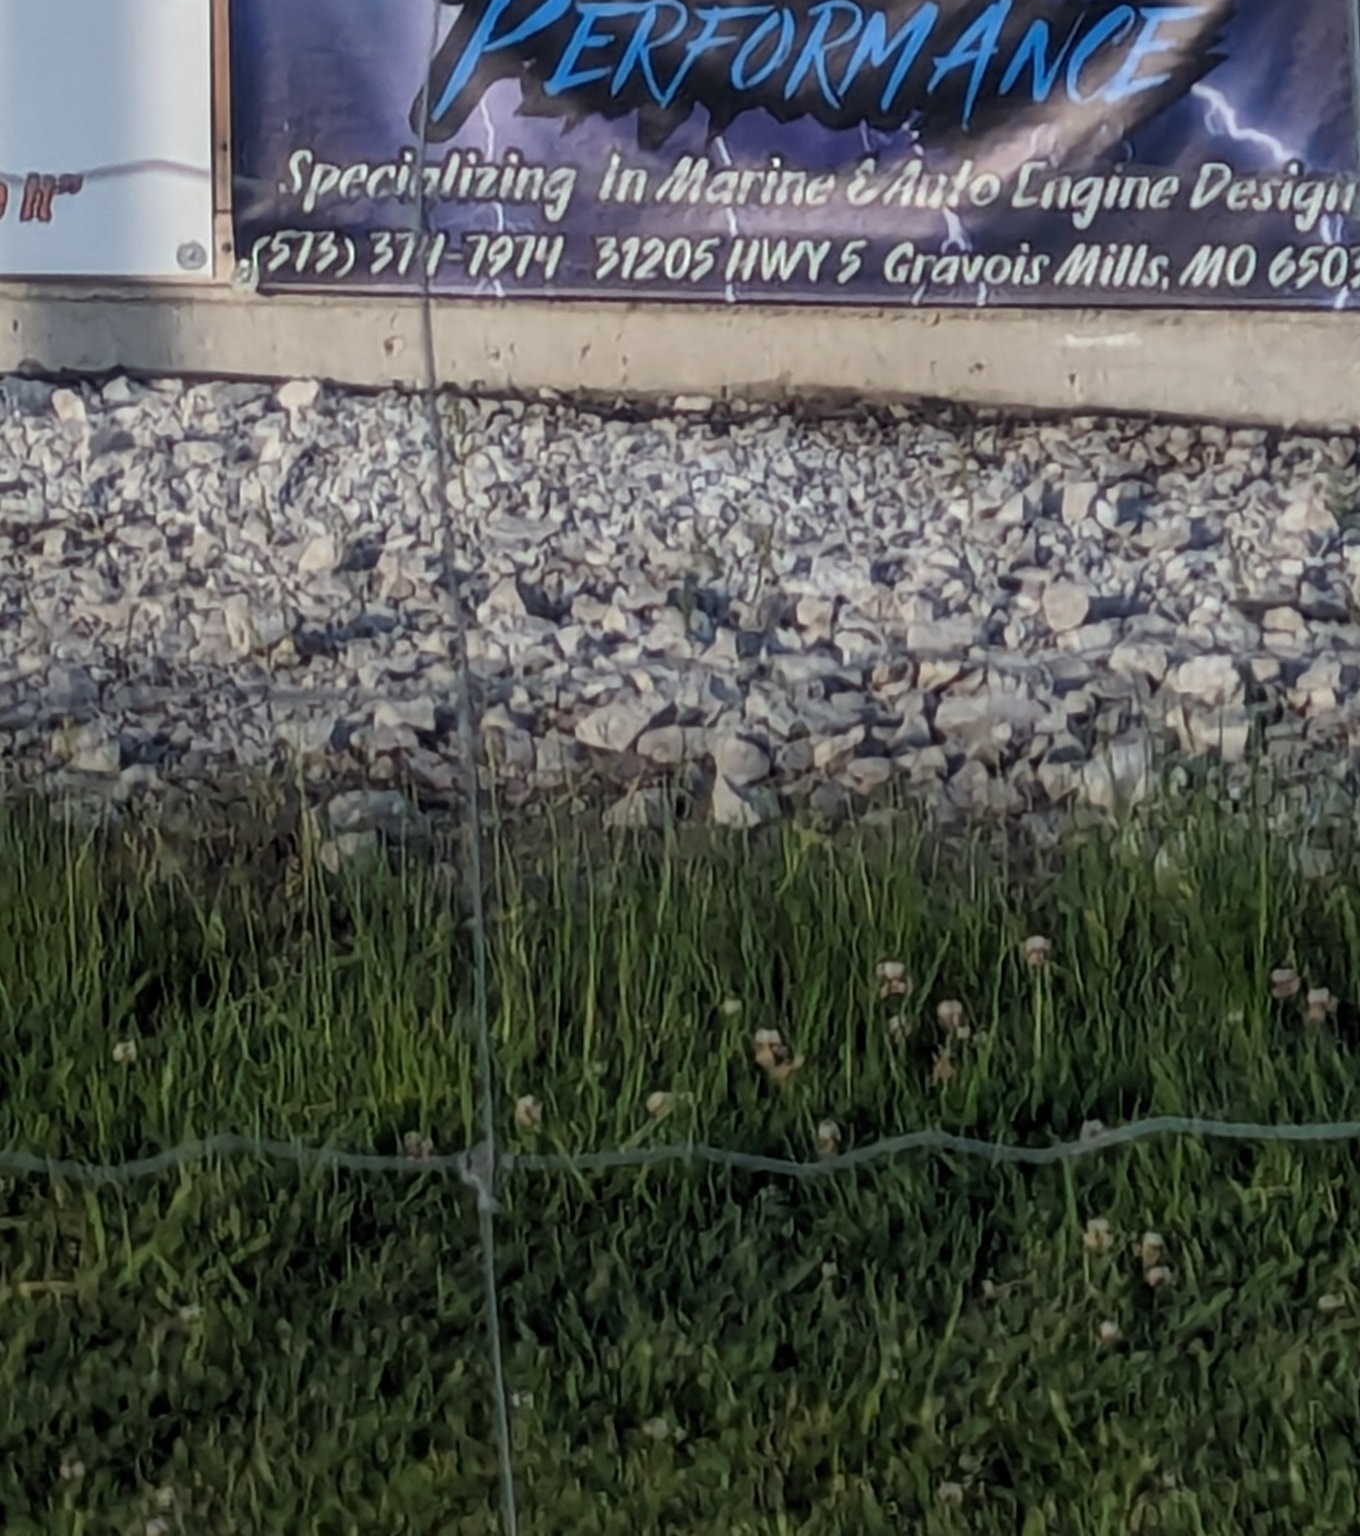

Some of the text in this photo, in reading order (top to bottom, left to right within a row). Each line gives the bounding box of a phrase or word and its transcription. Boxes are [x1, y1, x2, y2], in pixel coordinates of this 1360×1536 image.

[279, 149, 578, 223] Specializing
[599, 152, 648, 203] In
[655, 155, 835, 209] Marine
[1012, 161, 1180, 231] Engine
[1189, 162, 1360, 232] Design
[596, 235, 719, 284] 31205
[725, 237, 832, 284] HWY
[837, 241, 868, 283] 5
[884, 240, 1050, 288] Gravois
[1054, 243, 1170, 292] Mills,
[1178, 245, 1255, 288] MO
